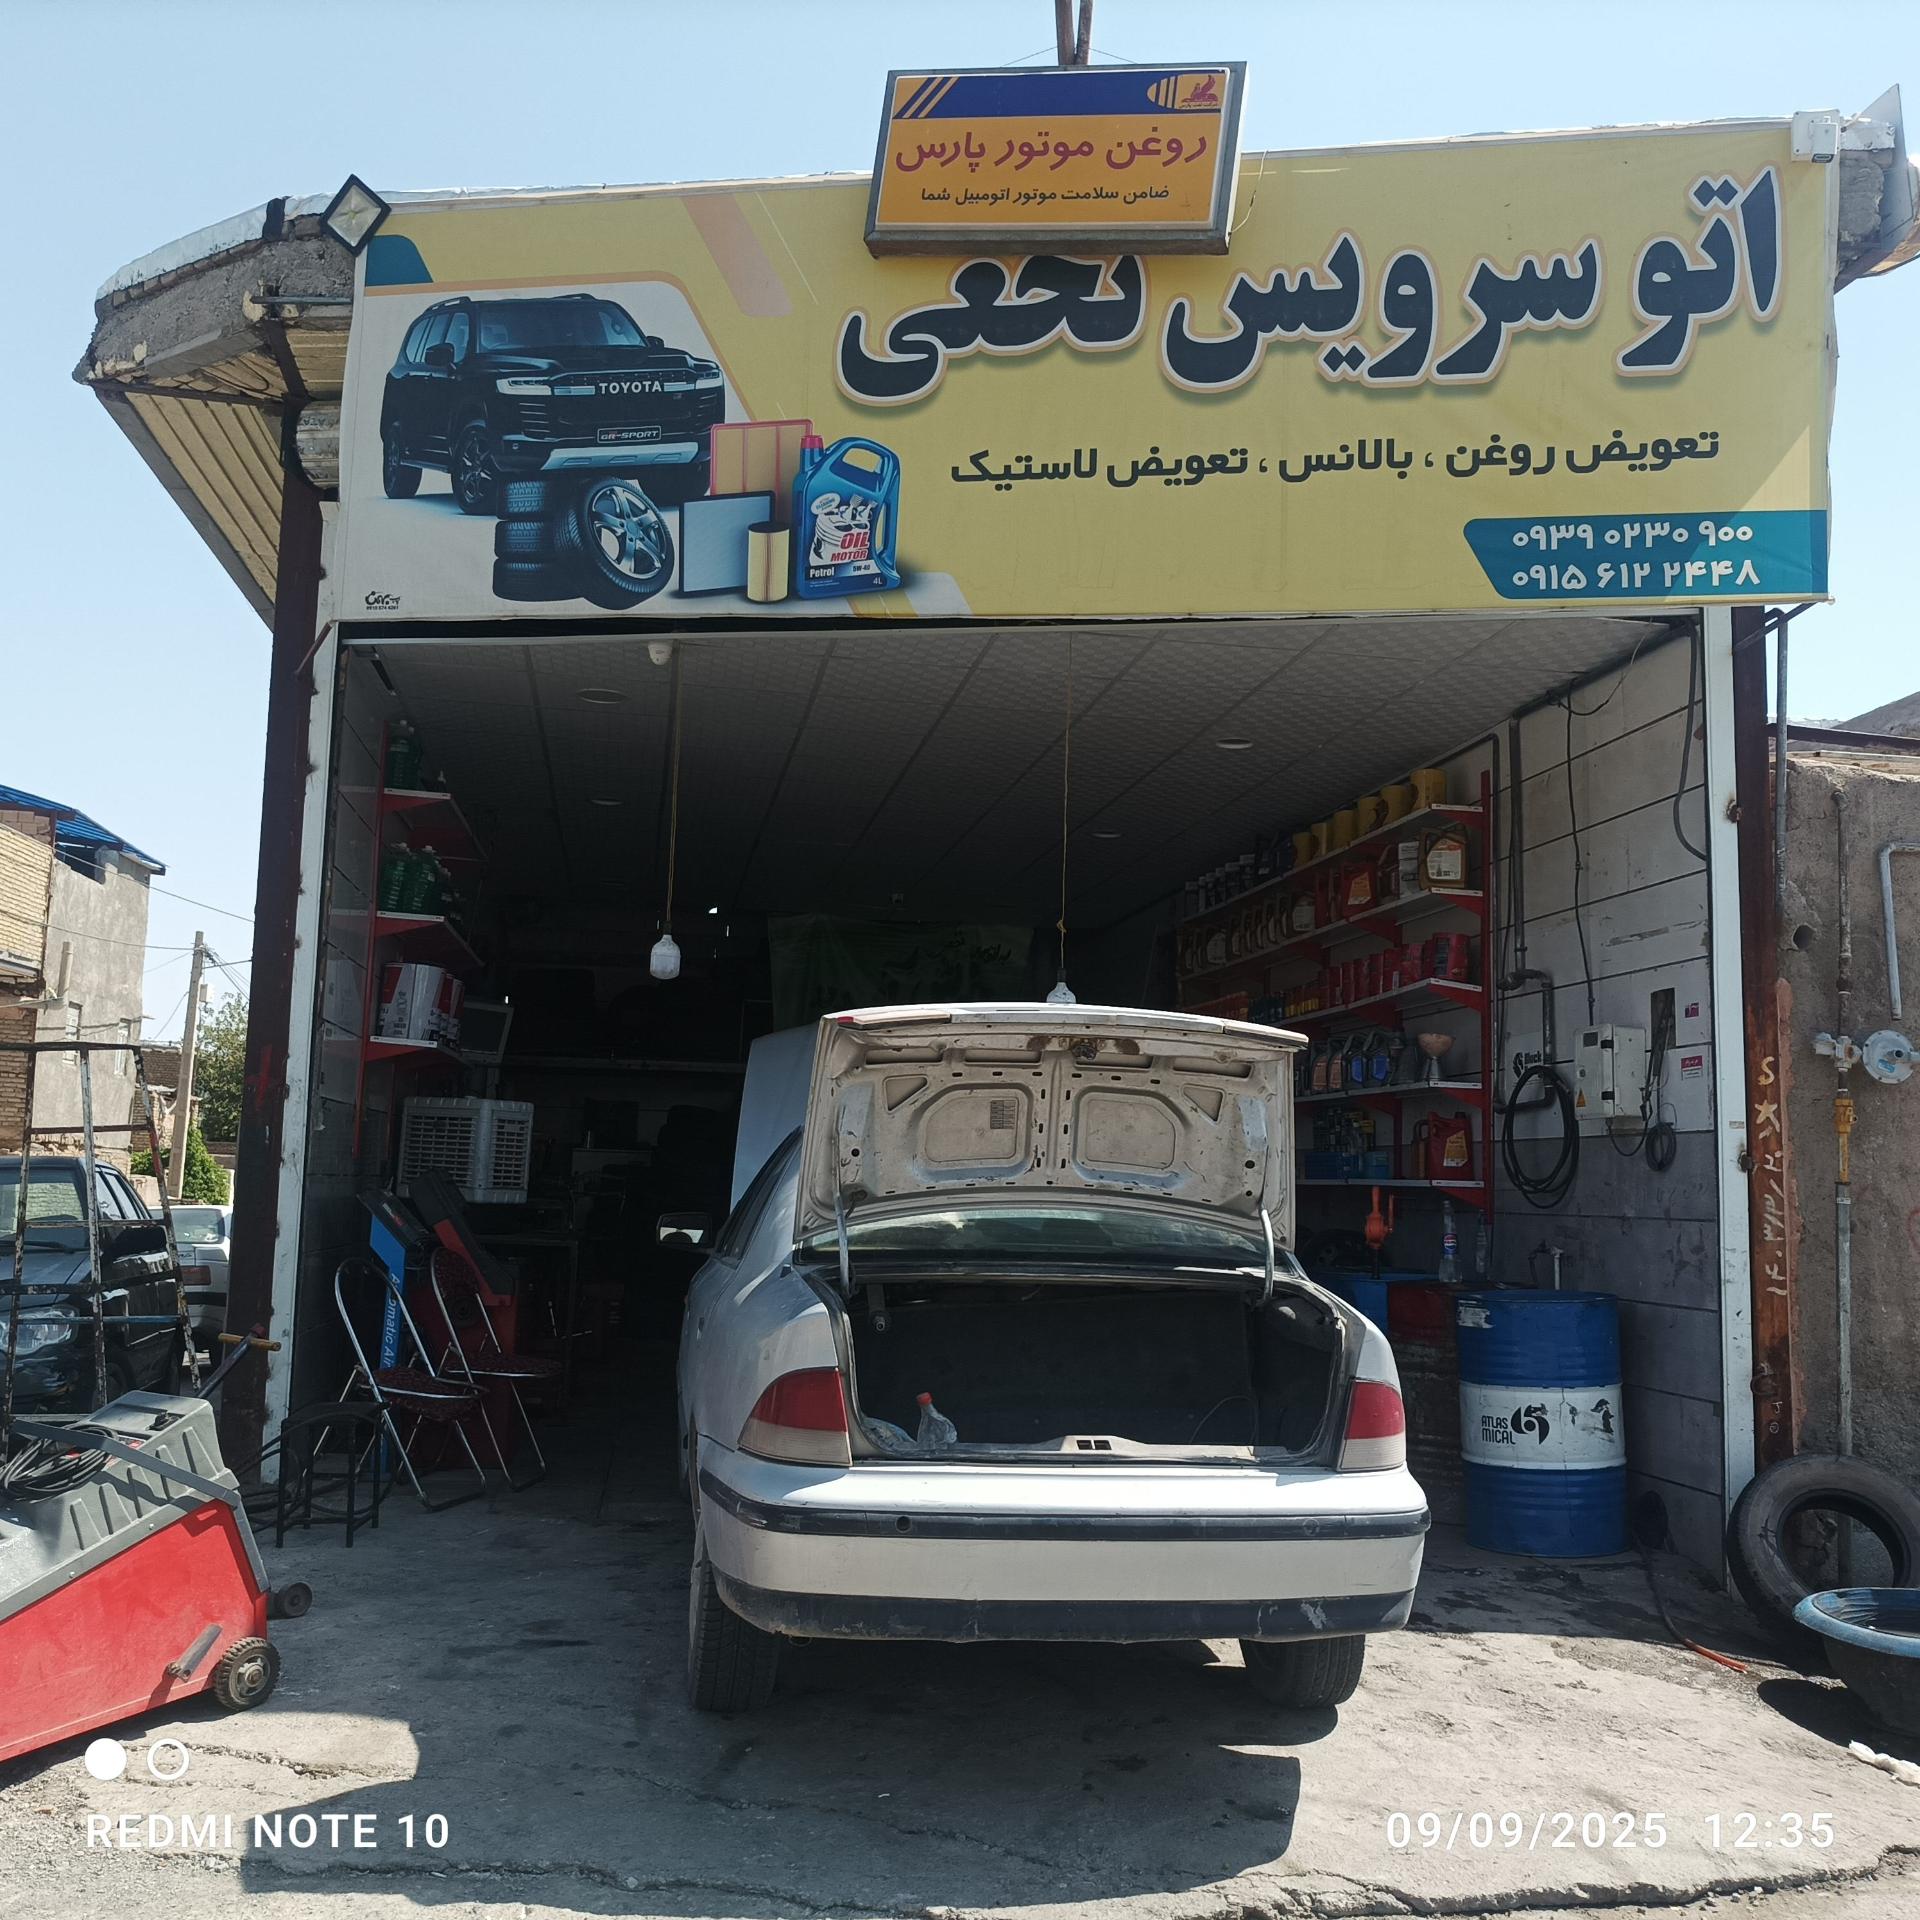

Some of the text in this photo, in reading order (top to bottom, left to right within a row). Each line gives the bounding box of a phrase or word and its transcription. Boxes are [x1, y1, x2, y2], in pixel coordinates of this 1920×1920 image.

[895, 126, 1207, 173] روغن موتور پارس
[921, 185, 1170, 206] ضامن سلامت موتور اتومبیل شما
[1616, 166, 1780, 370] اتو
[1163, 230, 1601, 387] سرویس
[599, 381, 662, 395] TOYOTA
[600, 430, 659, 441] GR-SPORT
[1106, 445, 1249, 488] تعویض
[1278, 437, 1413, 484] بالانس
[1445, 433, 1556, 478] روغن
[1565, 429, 1720, 474] تعویض
[950, 447, 1098, 492] لاستیک
[840, 531, 870, 550] OIL
[1512, 520, 1754, 551] ۰۹۳۹ ۰۲۳۰ ۹۰۰
[830, 550, 868, 562] MOTOR
[809, 567, 835, 579] Petrol
[872, 577, 883, 585] 4L
[1512, 559, 1761, 591] ۰۹۱۵ ۶۱۲ ۲۴۴۸
[384, 1272, 400, 1344] Aomatic
[1481, 1415, 1509, 1430] ATLAS
[1482, 1428, 1516, 1445] MICAL
